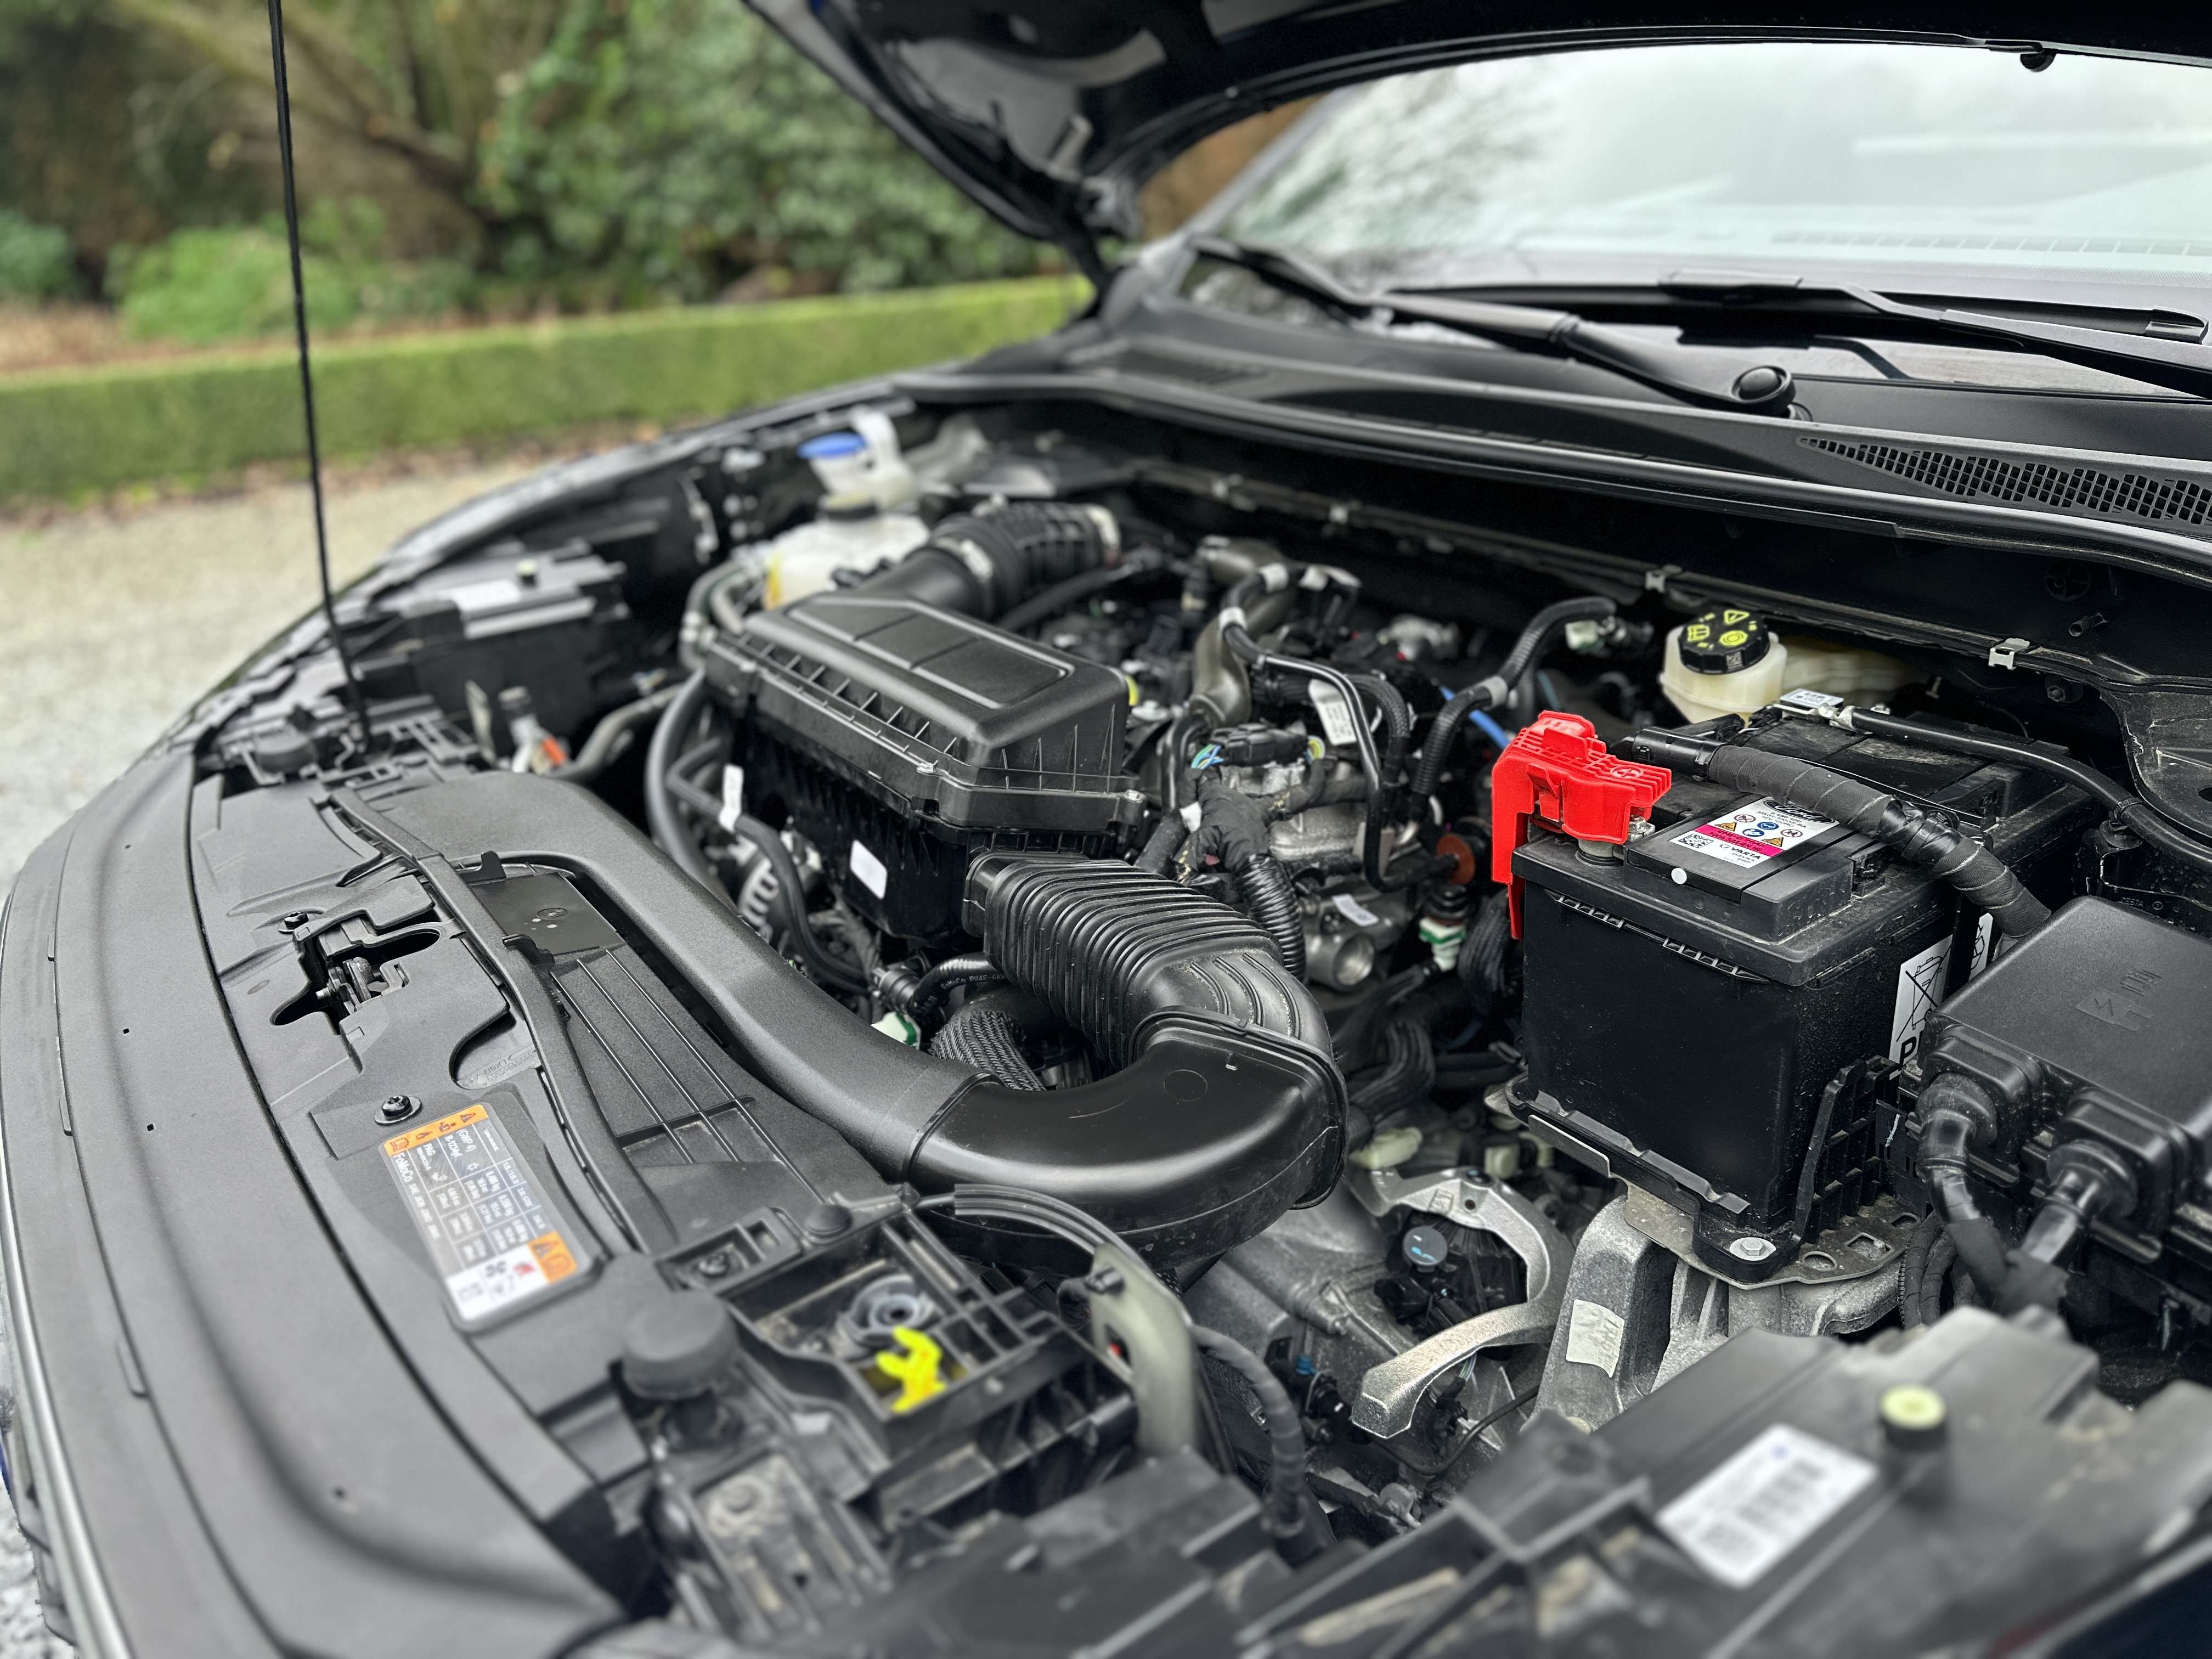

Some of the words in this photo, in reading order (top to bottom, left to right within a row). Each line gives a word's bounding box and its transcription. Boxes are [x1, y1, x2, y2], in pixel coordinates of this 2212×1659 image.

[1774, 805, 1822, 820] Ford
[1731, 847, 1761, 859] VARTA
[1899, 1036, 1917, 1065] P
[456, 1129, 473, 1143] (GWP
[424, 1143, 435, 1155] PAG
[445, 1135, 462, 1157] R-1234yf
[394, 1153, 413, 1182] FoMoCo
